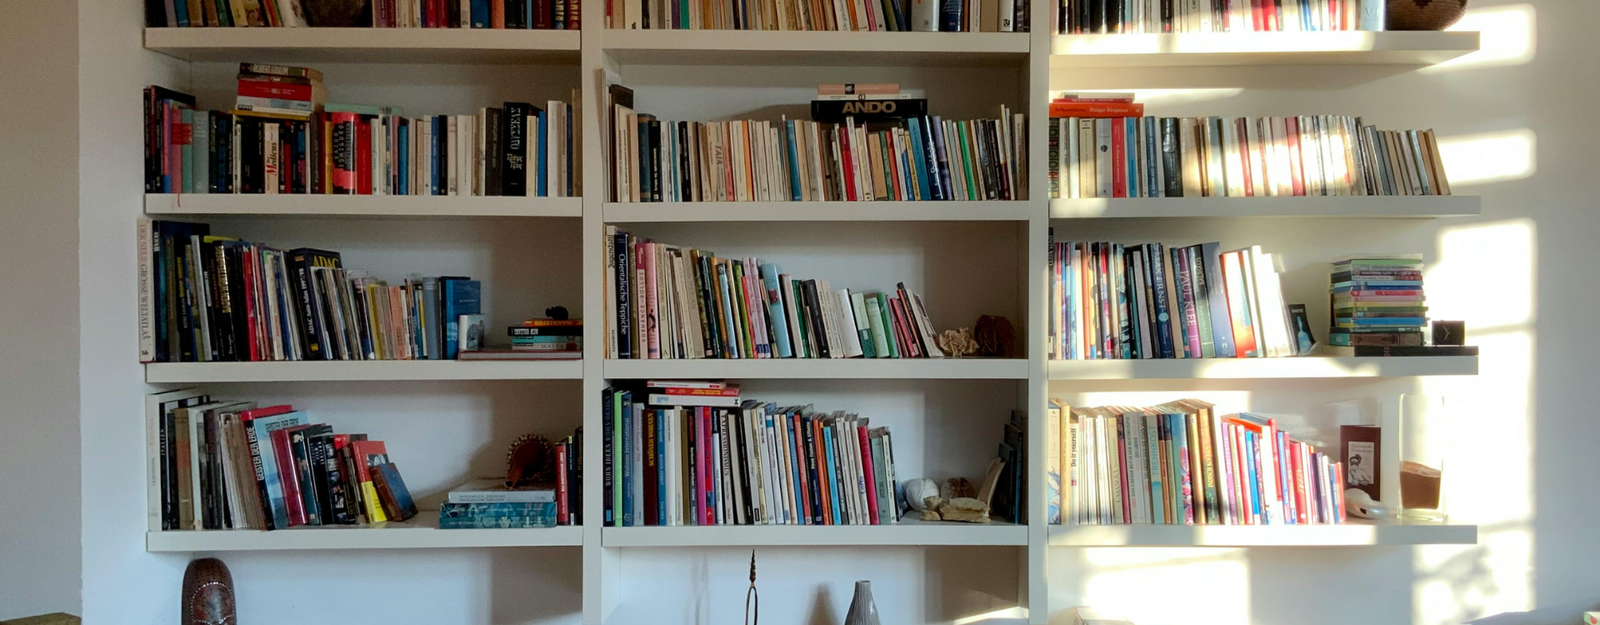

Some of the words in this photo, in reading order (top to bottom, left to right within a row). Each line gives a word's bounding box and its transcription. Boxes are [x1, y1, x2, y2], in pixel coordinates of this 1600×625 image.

[842, 101, 896, 114] ANDO
[140, 225, 148, 240] DER
[140, 241, 148, 262] NEUE
[313, 255, 339, 268] ADAC
[618, 253, 628, 302] Orientalische
[1196, 257, 1205, 285] BAUHAUS
[1155, 276, 1165, 310] ERNST
[1181, 270, 1191, 298] PAUL
[141, 296, 149, 340] WELTATLAS
[620, 303, 629, 335] Teppiche
[1185, 301, 1196, 327] KLEE
[246, 426, 256, 443] ERDE
[1070, 428, 1078, 453] yourself
[250, 443, 259, 456] DER
[1148, 425, 1160, 477] TRENNKOST
[252, 456, 265, 480] GEISTER
[1070, 458, 1076, 467] Do
